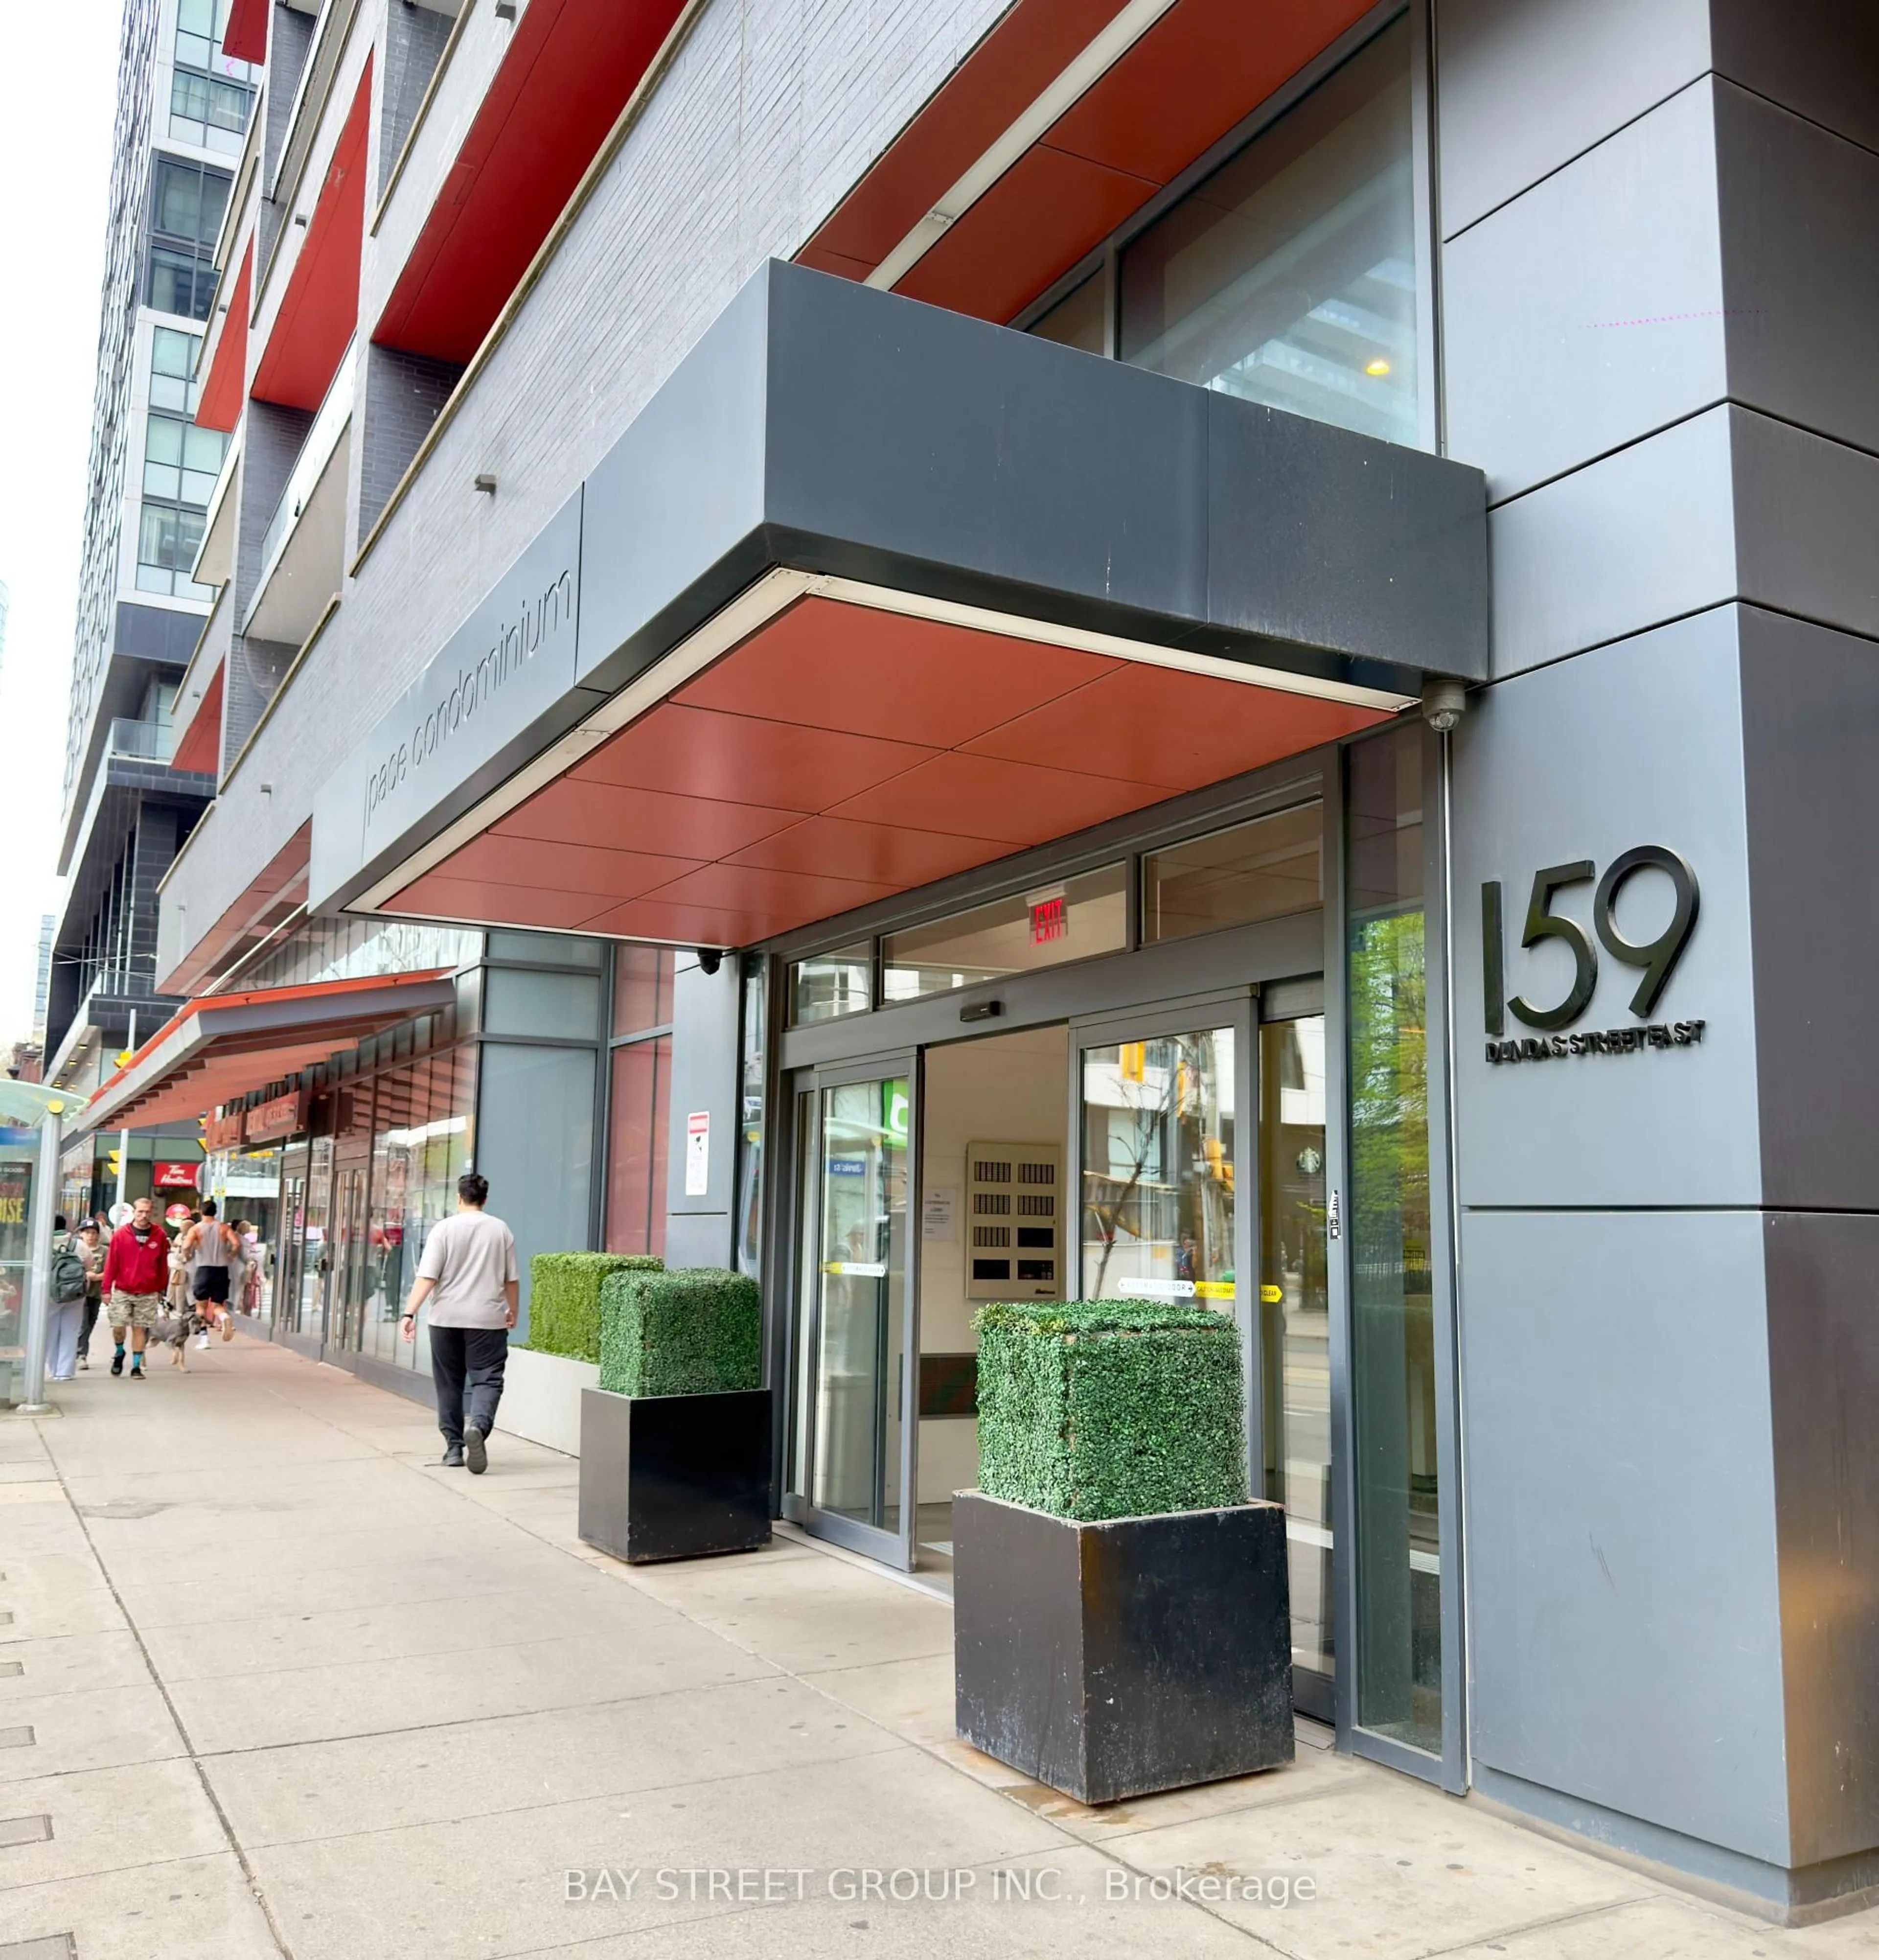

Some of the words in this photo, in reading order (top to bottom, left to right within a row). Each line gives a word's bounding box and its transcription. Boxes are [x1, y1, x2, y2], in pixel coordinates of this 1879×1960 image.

[368, 742, 407, 827] pace
[412, 569, 571, 767] condominium
[1034, 899, 1062, 944] EXIT
[1481, 845, 1700, 1036] 159
[1485, 1036, 1567, 1063] DUNDAS
[1569, 1026, 1648, 1055] STREET
[1648, 1019, 1705, 1048] EAST
